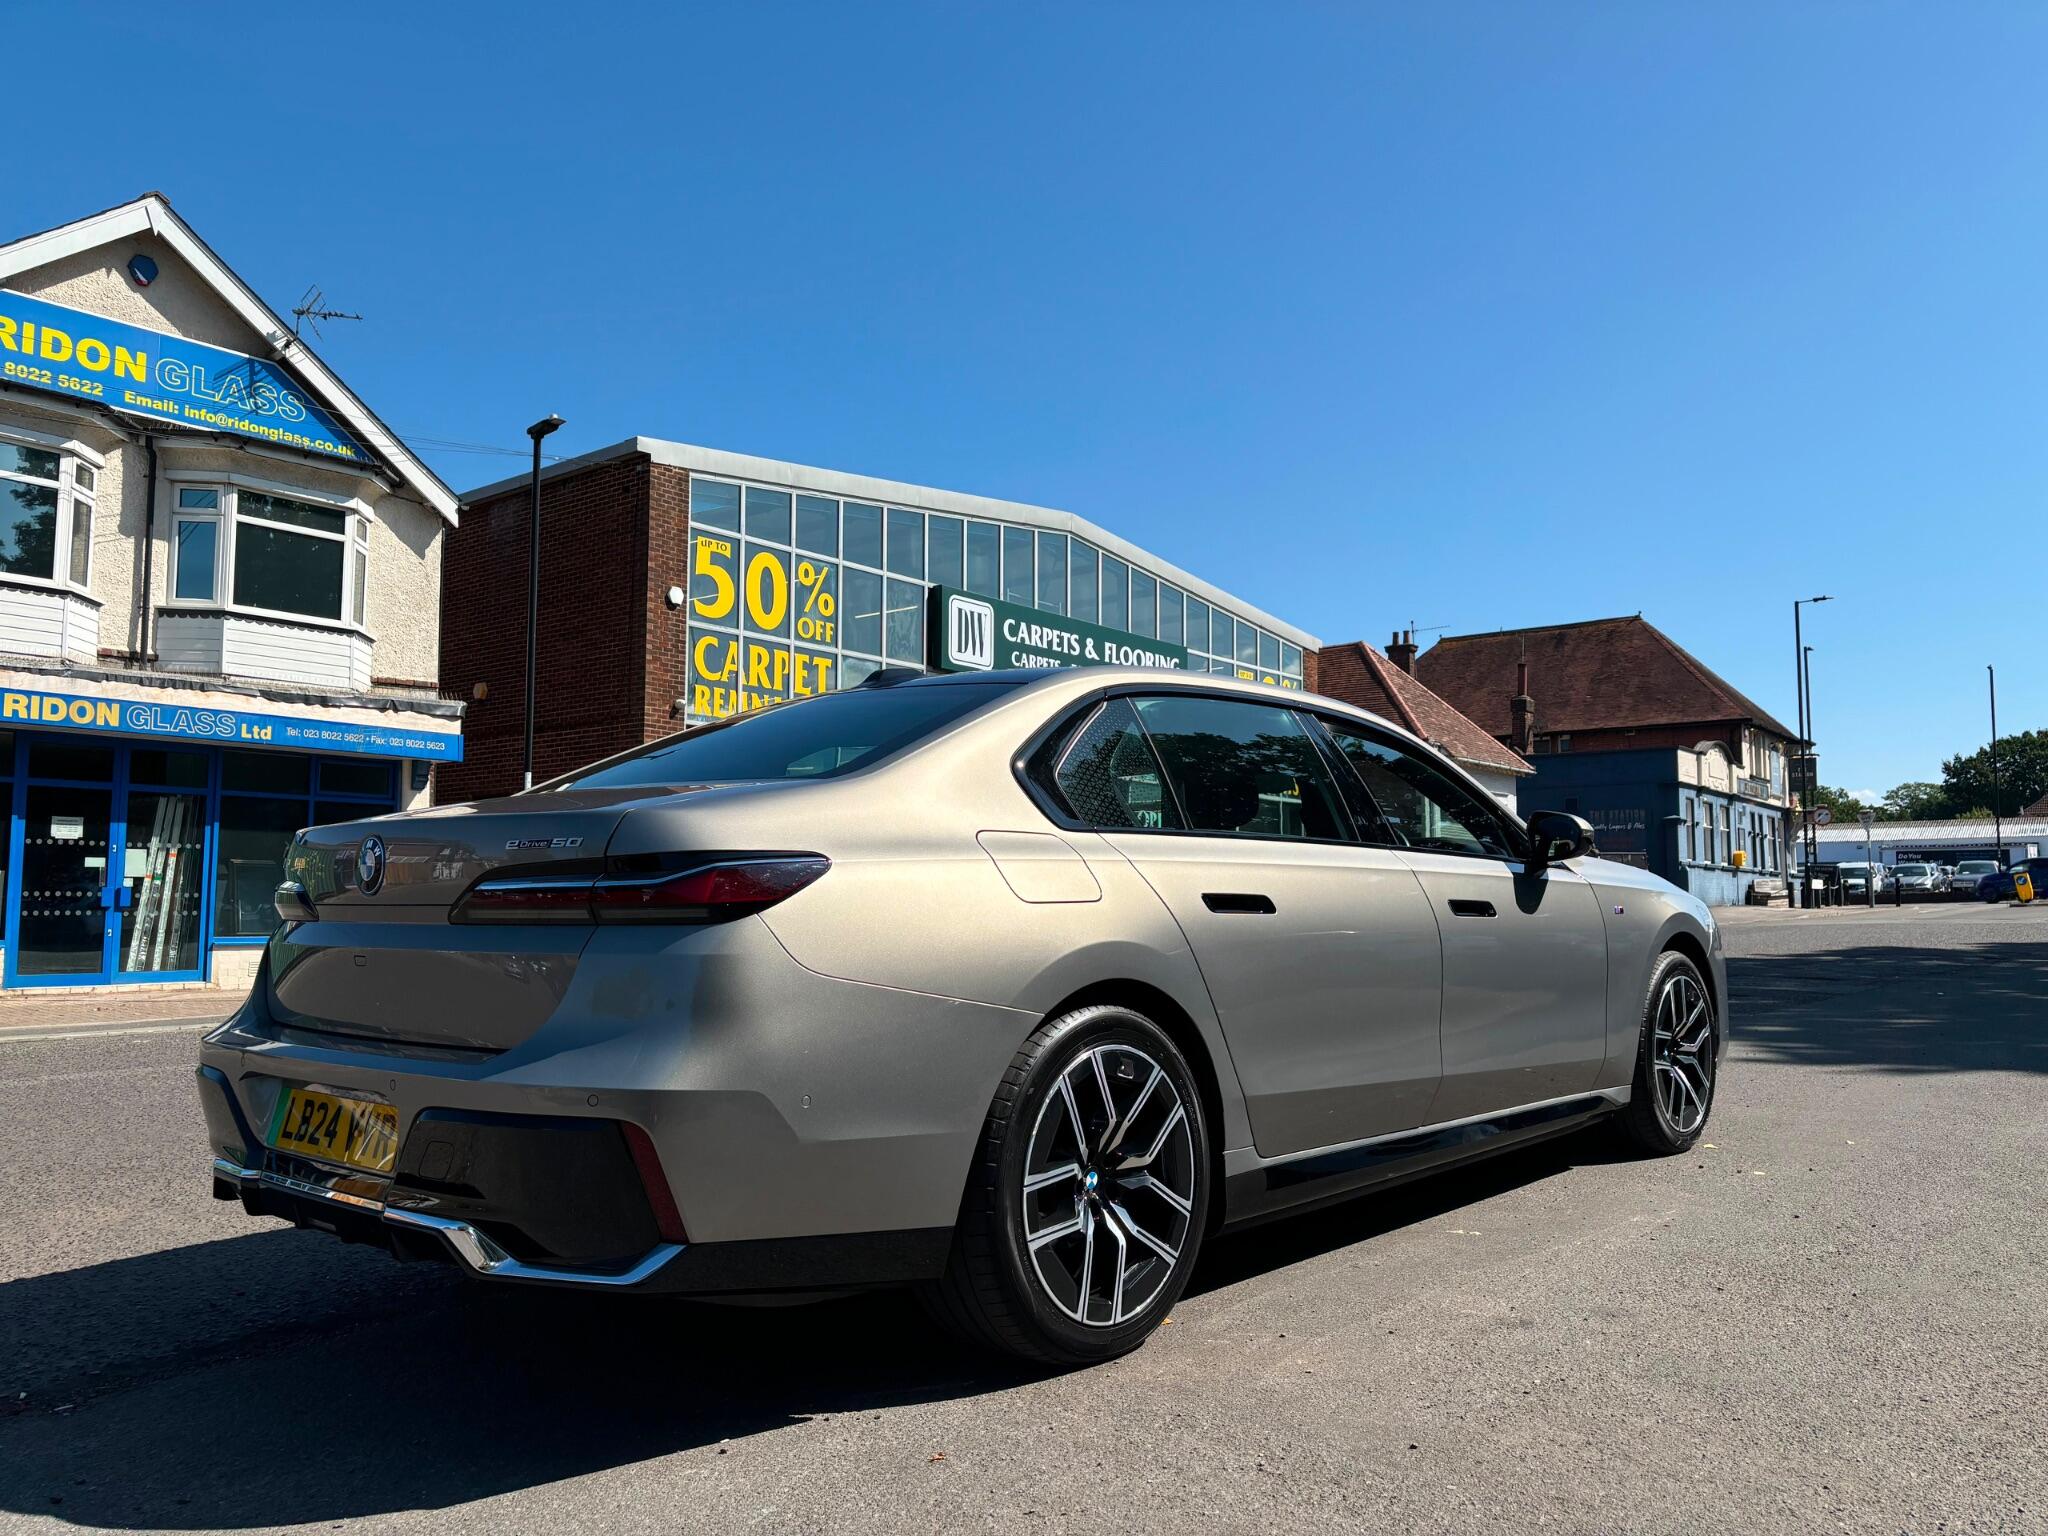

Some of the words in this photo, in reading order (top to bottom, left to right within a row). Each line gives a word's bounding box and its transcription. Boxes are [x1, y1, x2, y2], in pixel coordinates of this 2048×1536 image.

[4, 361, 52, 384] 8022
[58, 374, 103, 396] 5622
[124, 391, 179, 414] Email:
[184, 404, 355, 457] info@ridonglass.co.uk
[155, 358, 306, 422] GLASS
[701, 539, 714, 549] UP
[715, 541, 728, 552] TO
[797, 617, 834, 643] OFF
[956, 607, 988, 658] DW
[1003, 618, 1081, 656] CARPETS
[1085, 637, 1100, 661] &
[694, 635, 833, 697] CARPET
[3, 692, 120, 727] RIDON
[127, 705, 236, 737] GLASS
[241, 723, 272, 740] Ltd
[286, 727, 301, 736] Tel:
[303, 730, 319, 738] 023
[322, 731, 342, 740] 8022
[371, 735, 387, 745] Fax:
[389, 737, 403, 746] 023
[281, 1096, 343, 1149] LB24
